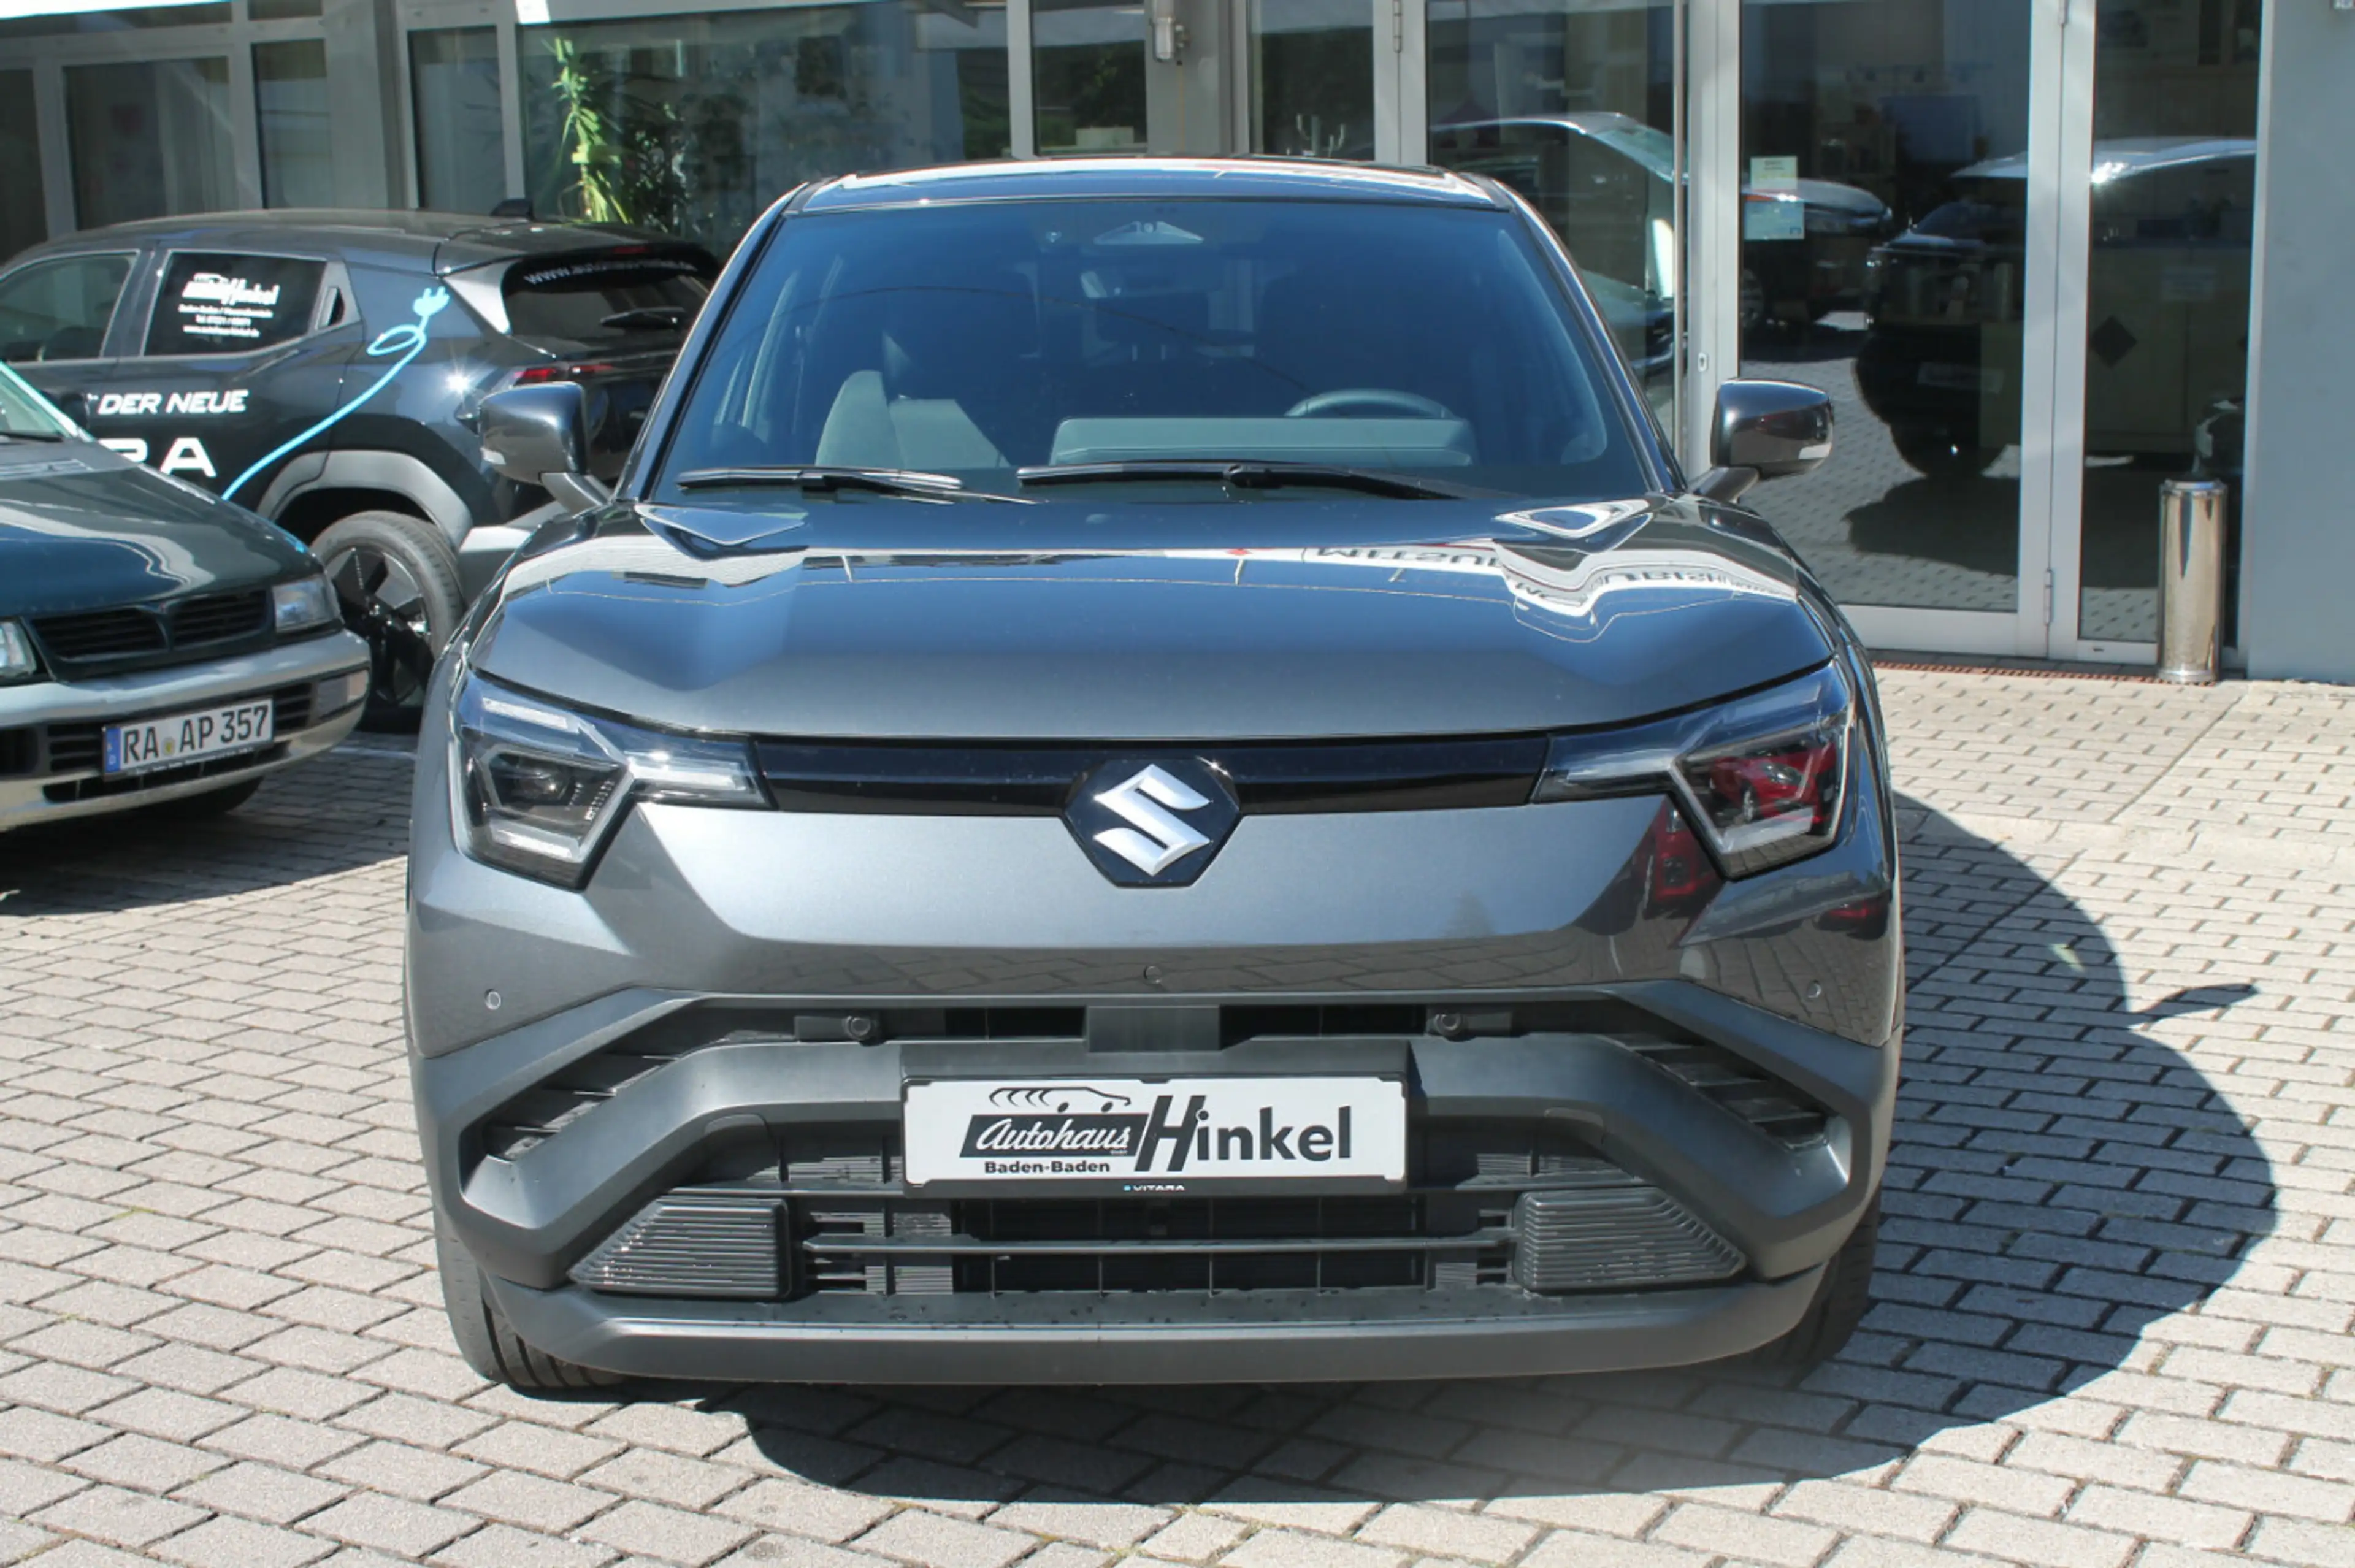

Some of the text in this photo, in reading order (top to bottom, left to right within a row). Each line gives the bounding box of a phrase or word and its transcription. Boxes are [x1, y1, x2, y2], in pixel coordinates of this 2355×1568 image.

[97, 389, 249, 415] DER NEUE
[123, 704, 269, 763] RA AP 357
[976, 1095, 1352, 1172] Autohaus Hinkel
[984, 1161, 1111, 1174] Baden-Baden
